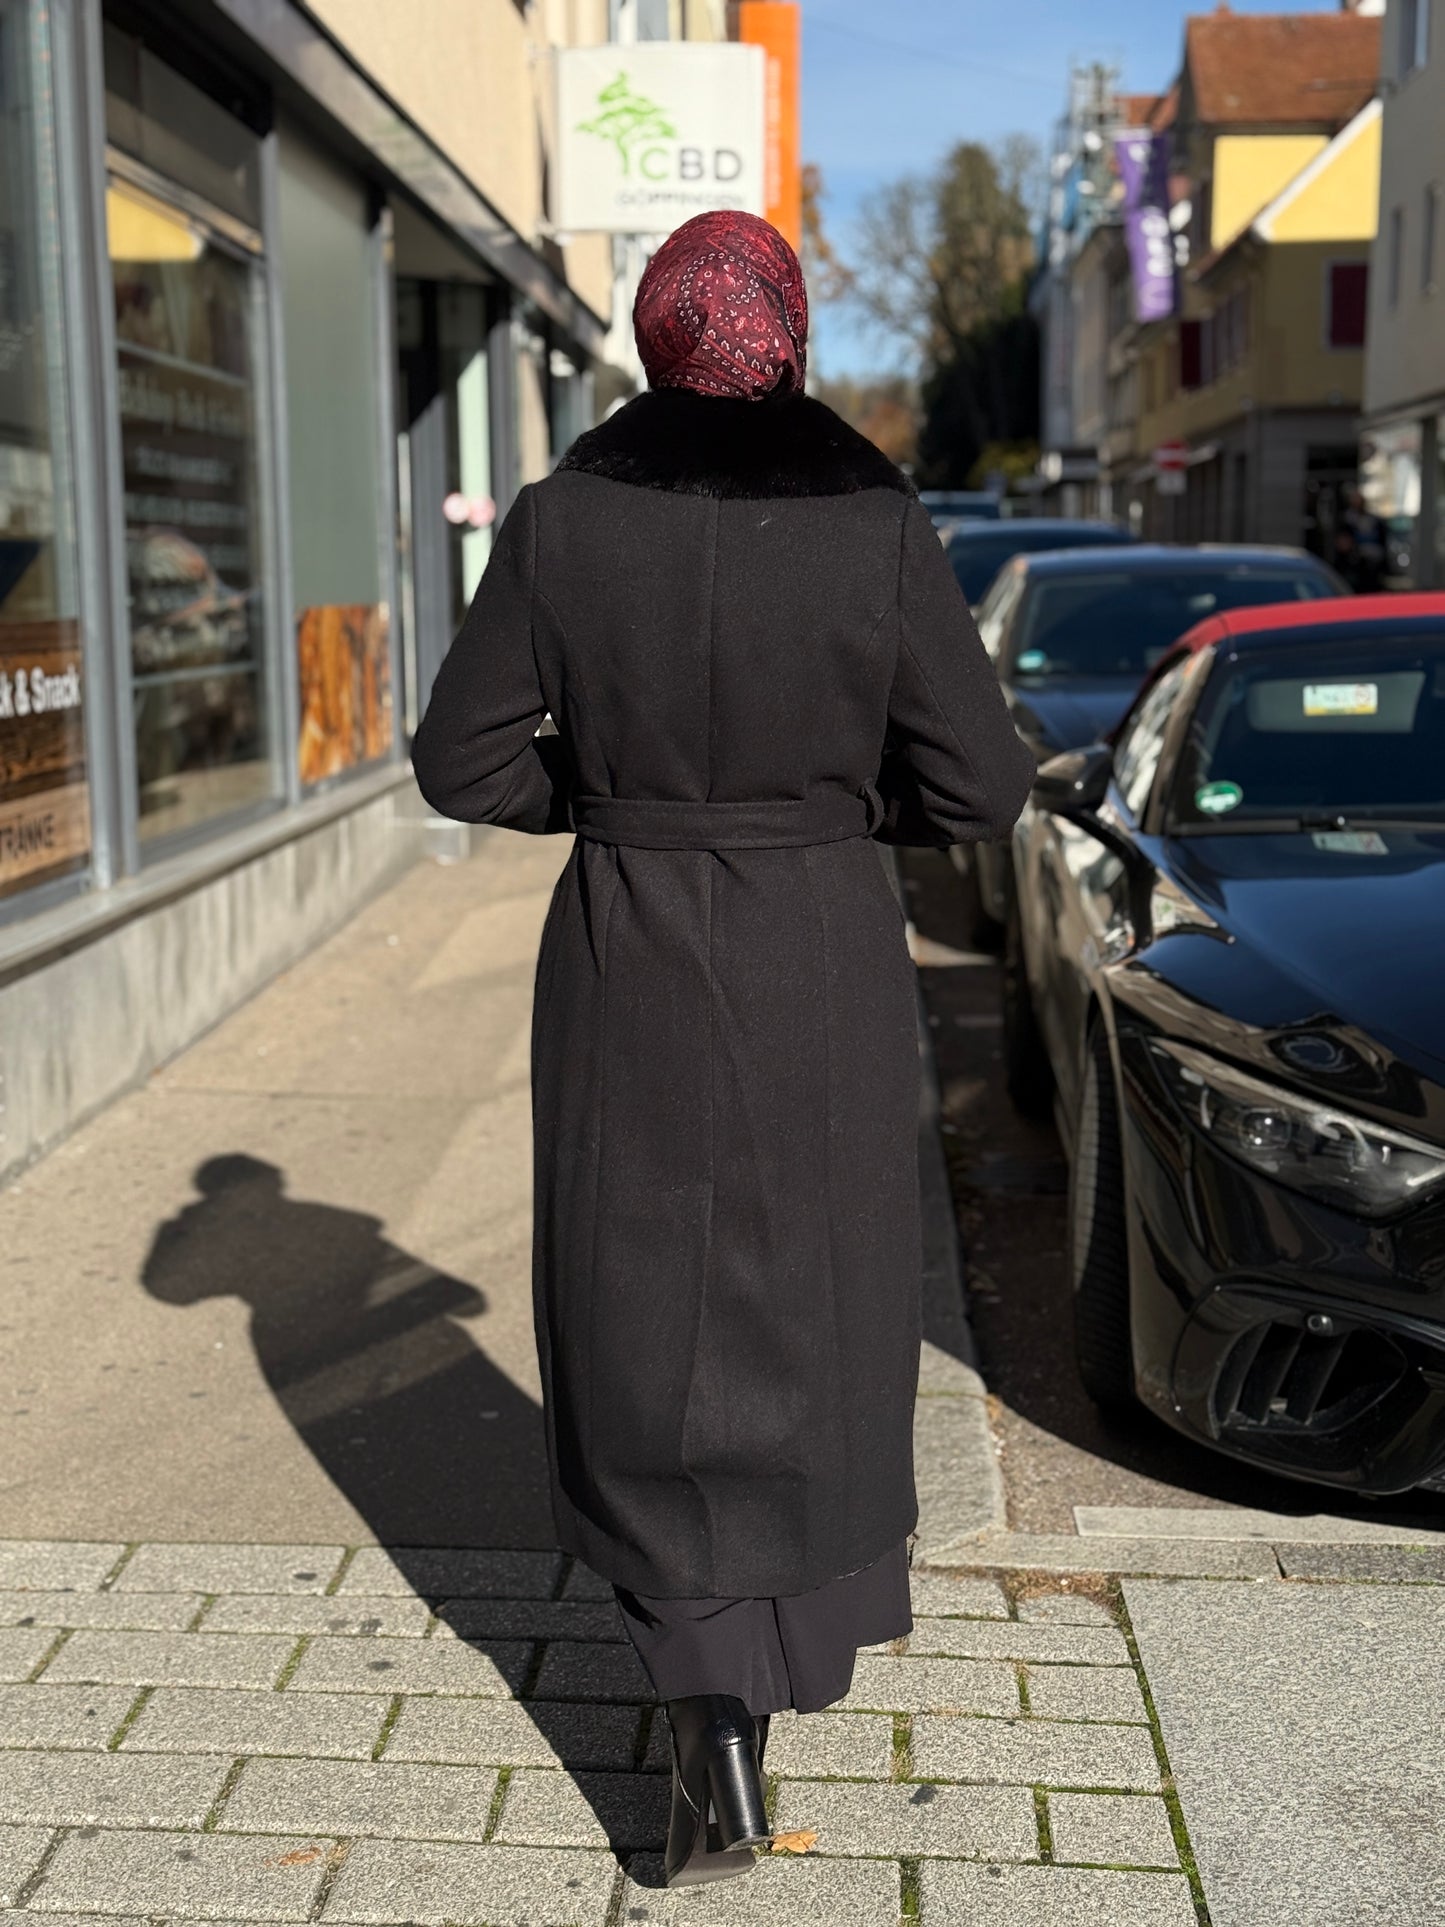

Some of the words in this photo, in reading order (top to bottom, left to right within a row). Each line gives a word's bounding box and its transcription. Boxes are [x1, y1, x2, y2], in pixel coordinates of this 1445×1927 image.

[639, 148, 742, 181] CBD
[14, 667, 31, 717] &
[30, 663, 81, 714] Snack
